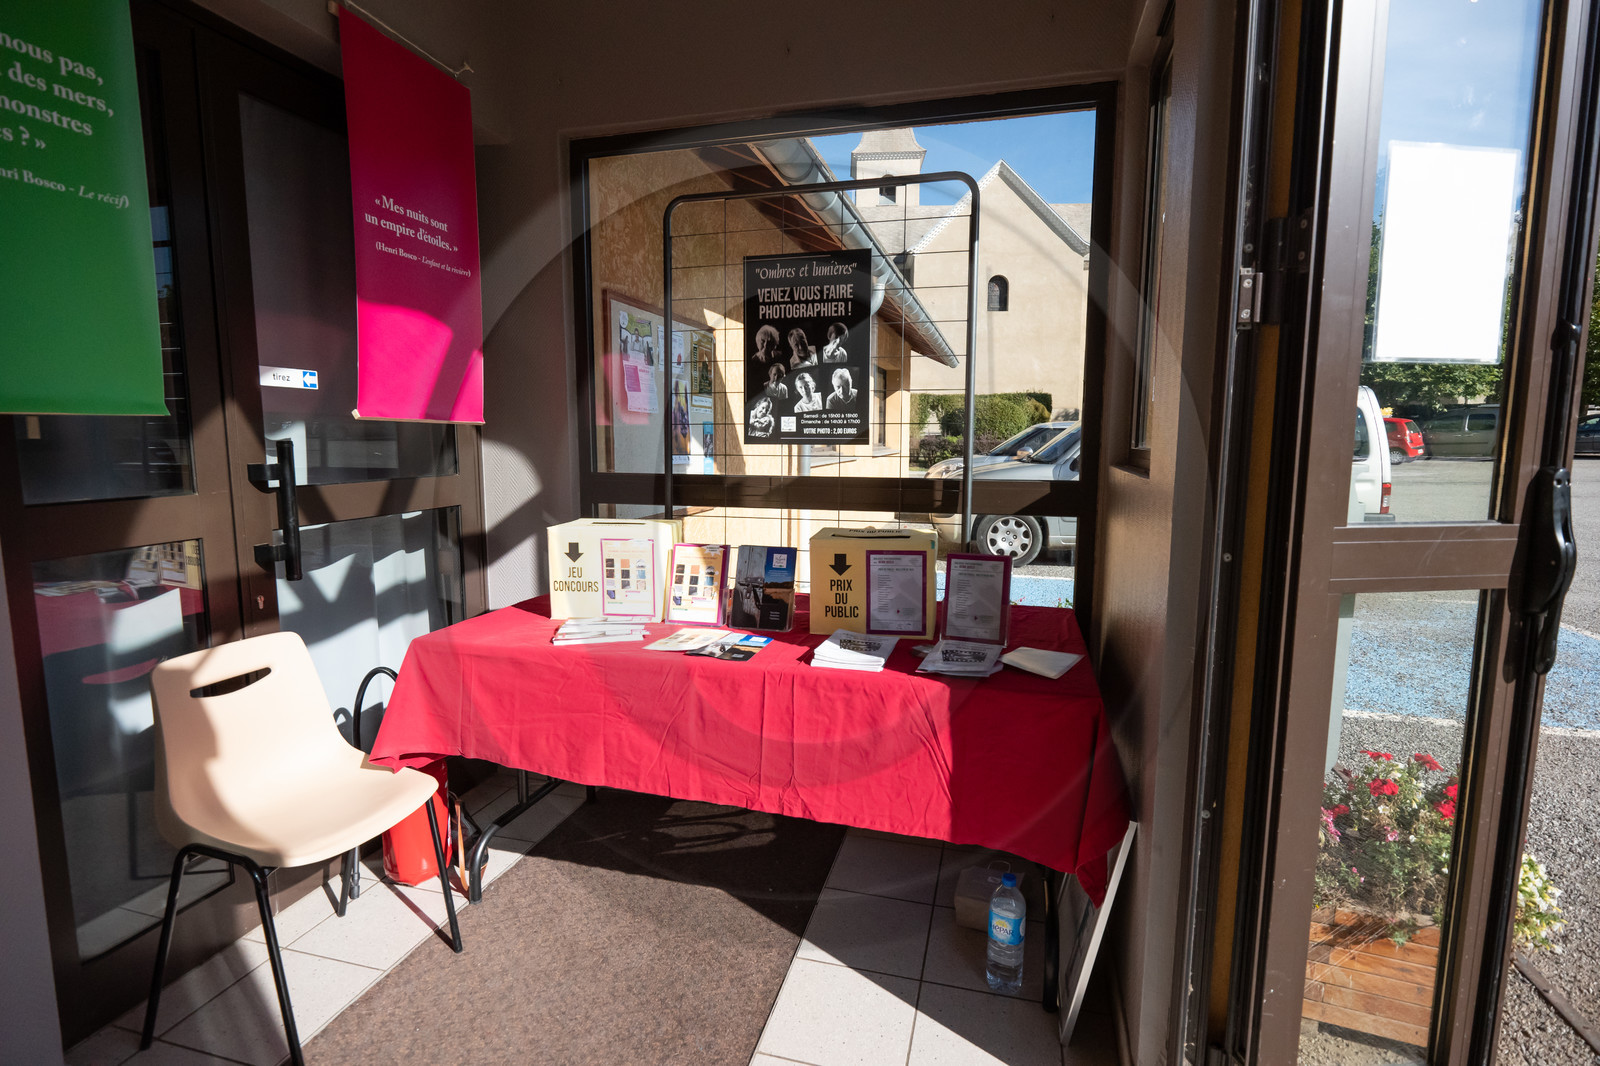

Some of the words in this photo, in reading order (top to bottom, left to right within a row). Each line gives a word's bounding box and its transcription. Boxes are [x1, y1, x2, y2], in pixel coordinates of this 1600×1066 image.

[59, 56, 103, 86] pas,
[8, 61, 47, 91] des
[52, 83, 114, 118] mers,
[22, 170, 66, 192] Bosco
[79, 185, 94, 199] Le
[365, 213, 378, 225] un
[380, 218, 415, 237] empire
[406, 209, 428, 224] nuits
[430, 218, 448, 232] sont
[376, 241, 398, 255] (Henri
[399, 248, 417, 261] Bosco
[799, 264, 809, 277] et
[812, 260, 858, 277] lumières"
[758, 287, 790, 302] VENEZ
[794, 286, 820, 300] VOUS
[824, 284, 854, 300] FAIRE
[759, 302, 845, 320] PHOTOGRAPHIER
[273, 373, 290, 381] tirez
[568, 566, 583, 578] JEU
[554, 580, 599, 592] CONCOURS
[830, 579, 852, 592] PRIX
[835, 593, 848, 604] DU
[825, 606, 859, 618] PUBLIC
